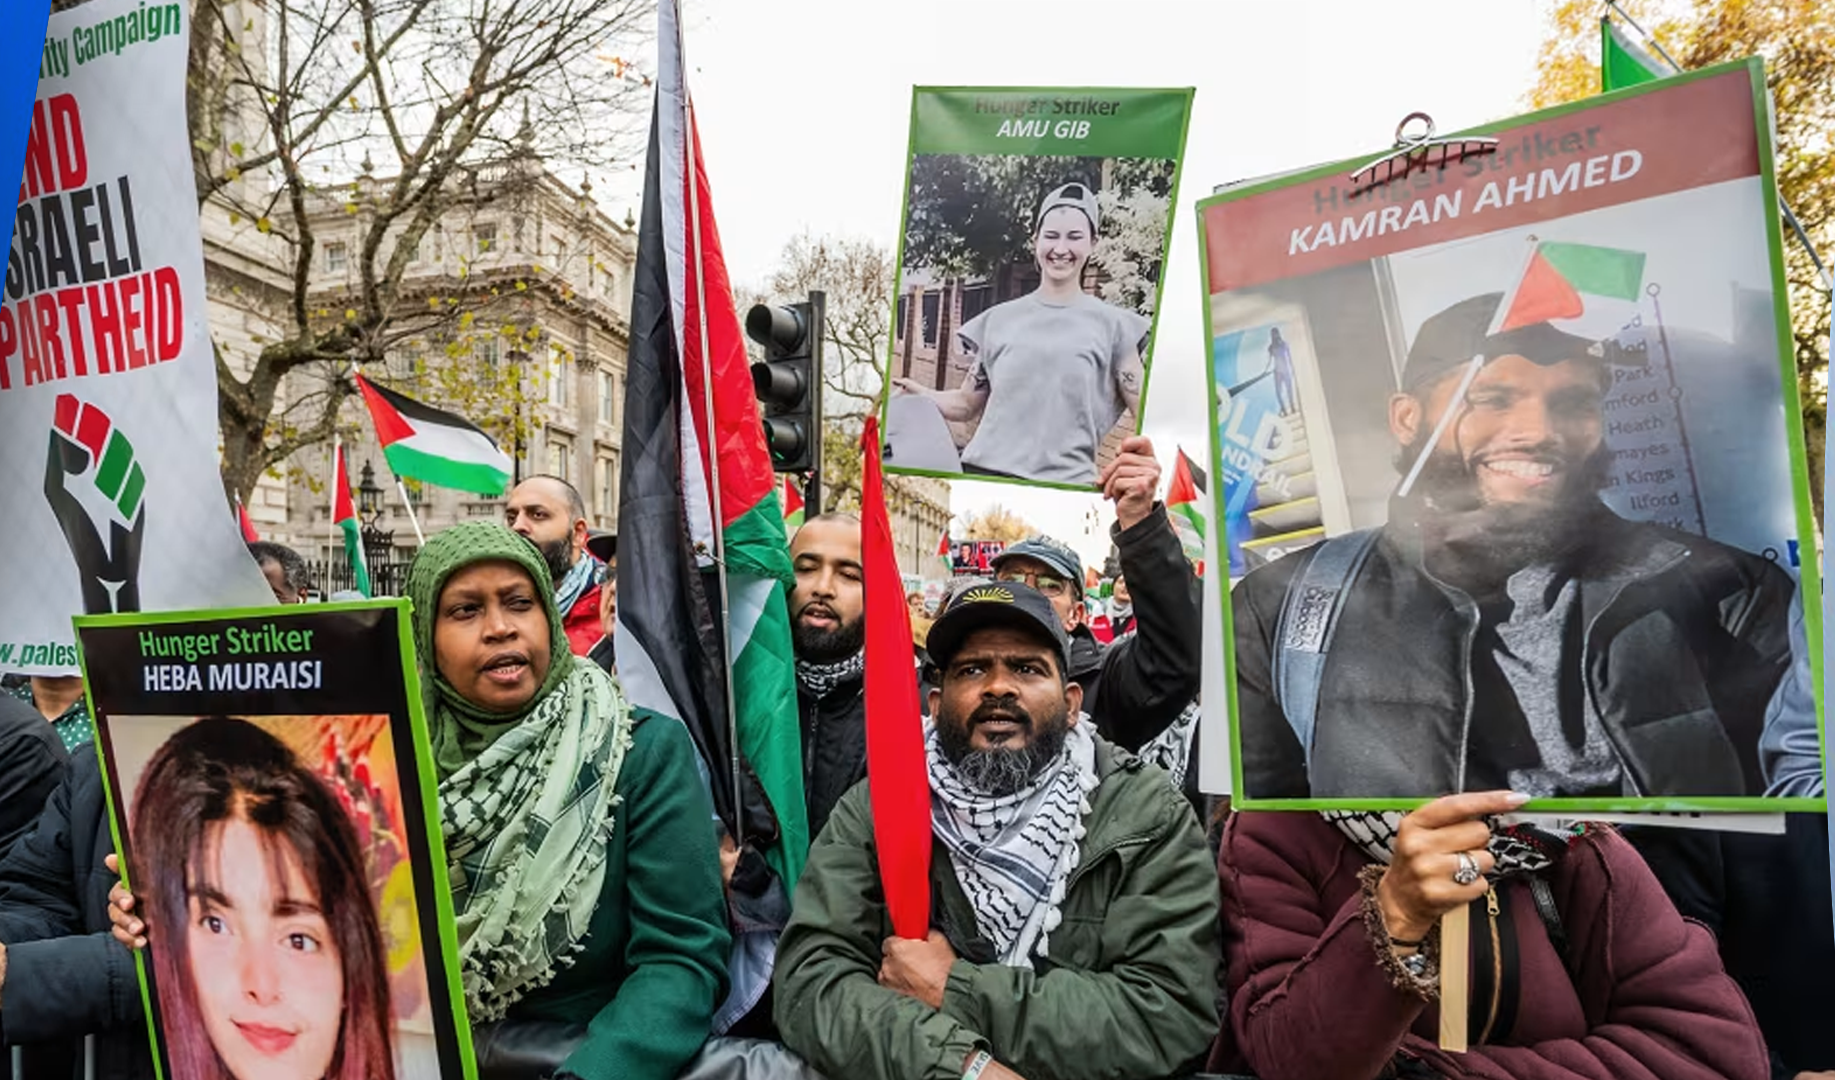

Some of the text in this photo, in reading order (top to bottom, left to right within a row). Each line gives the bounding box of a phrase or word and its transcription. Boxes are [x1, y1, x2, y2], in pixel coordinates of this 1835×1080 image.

[72, 1, 181, 65] Campaign
[975, 96, 1120, 117] Hunger Striker
[996, 119, 1091, 139] AMU GIB
[17, 93, 88, 204] ND
[1462, 126, 1602, 177] Striker
[1287, 148, 1644, 255] KAMRAN AHMED
[3, 175, 142, 303] SRAELI
[1614, 366, 1653, 382] Park
[1608, 416, 1665, 436] Heath
[1625, 468, 1676, 486] Kings
[1630, 491, 1680, 511] Ilford
[0, 641, 77, 668] w.pales
[139, 622, 314, 662] Hunger Striker
[143, 660, 323, 692] HEBA MURAISI
